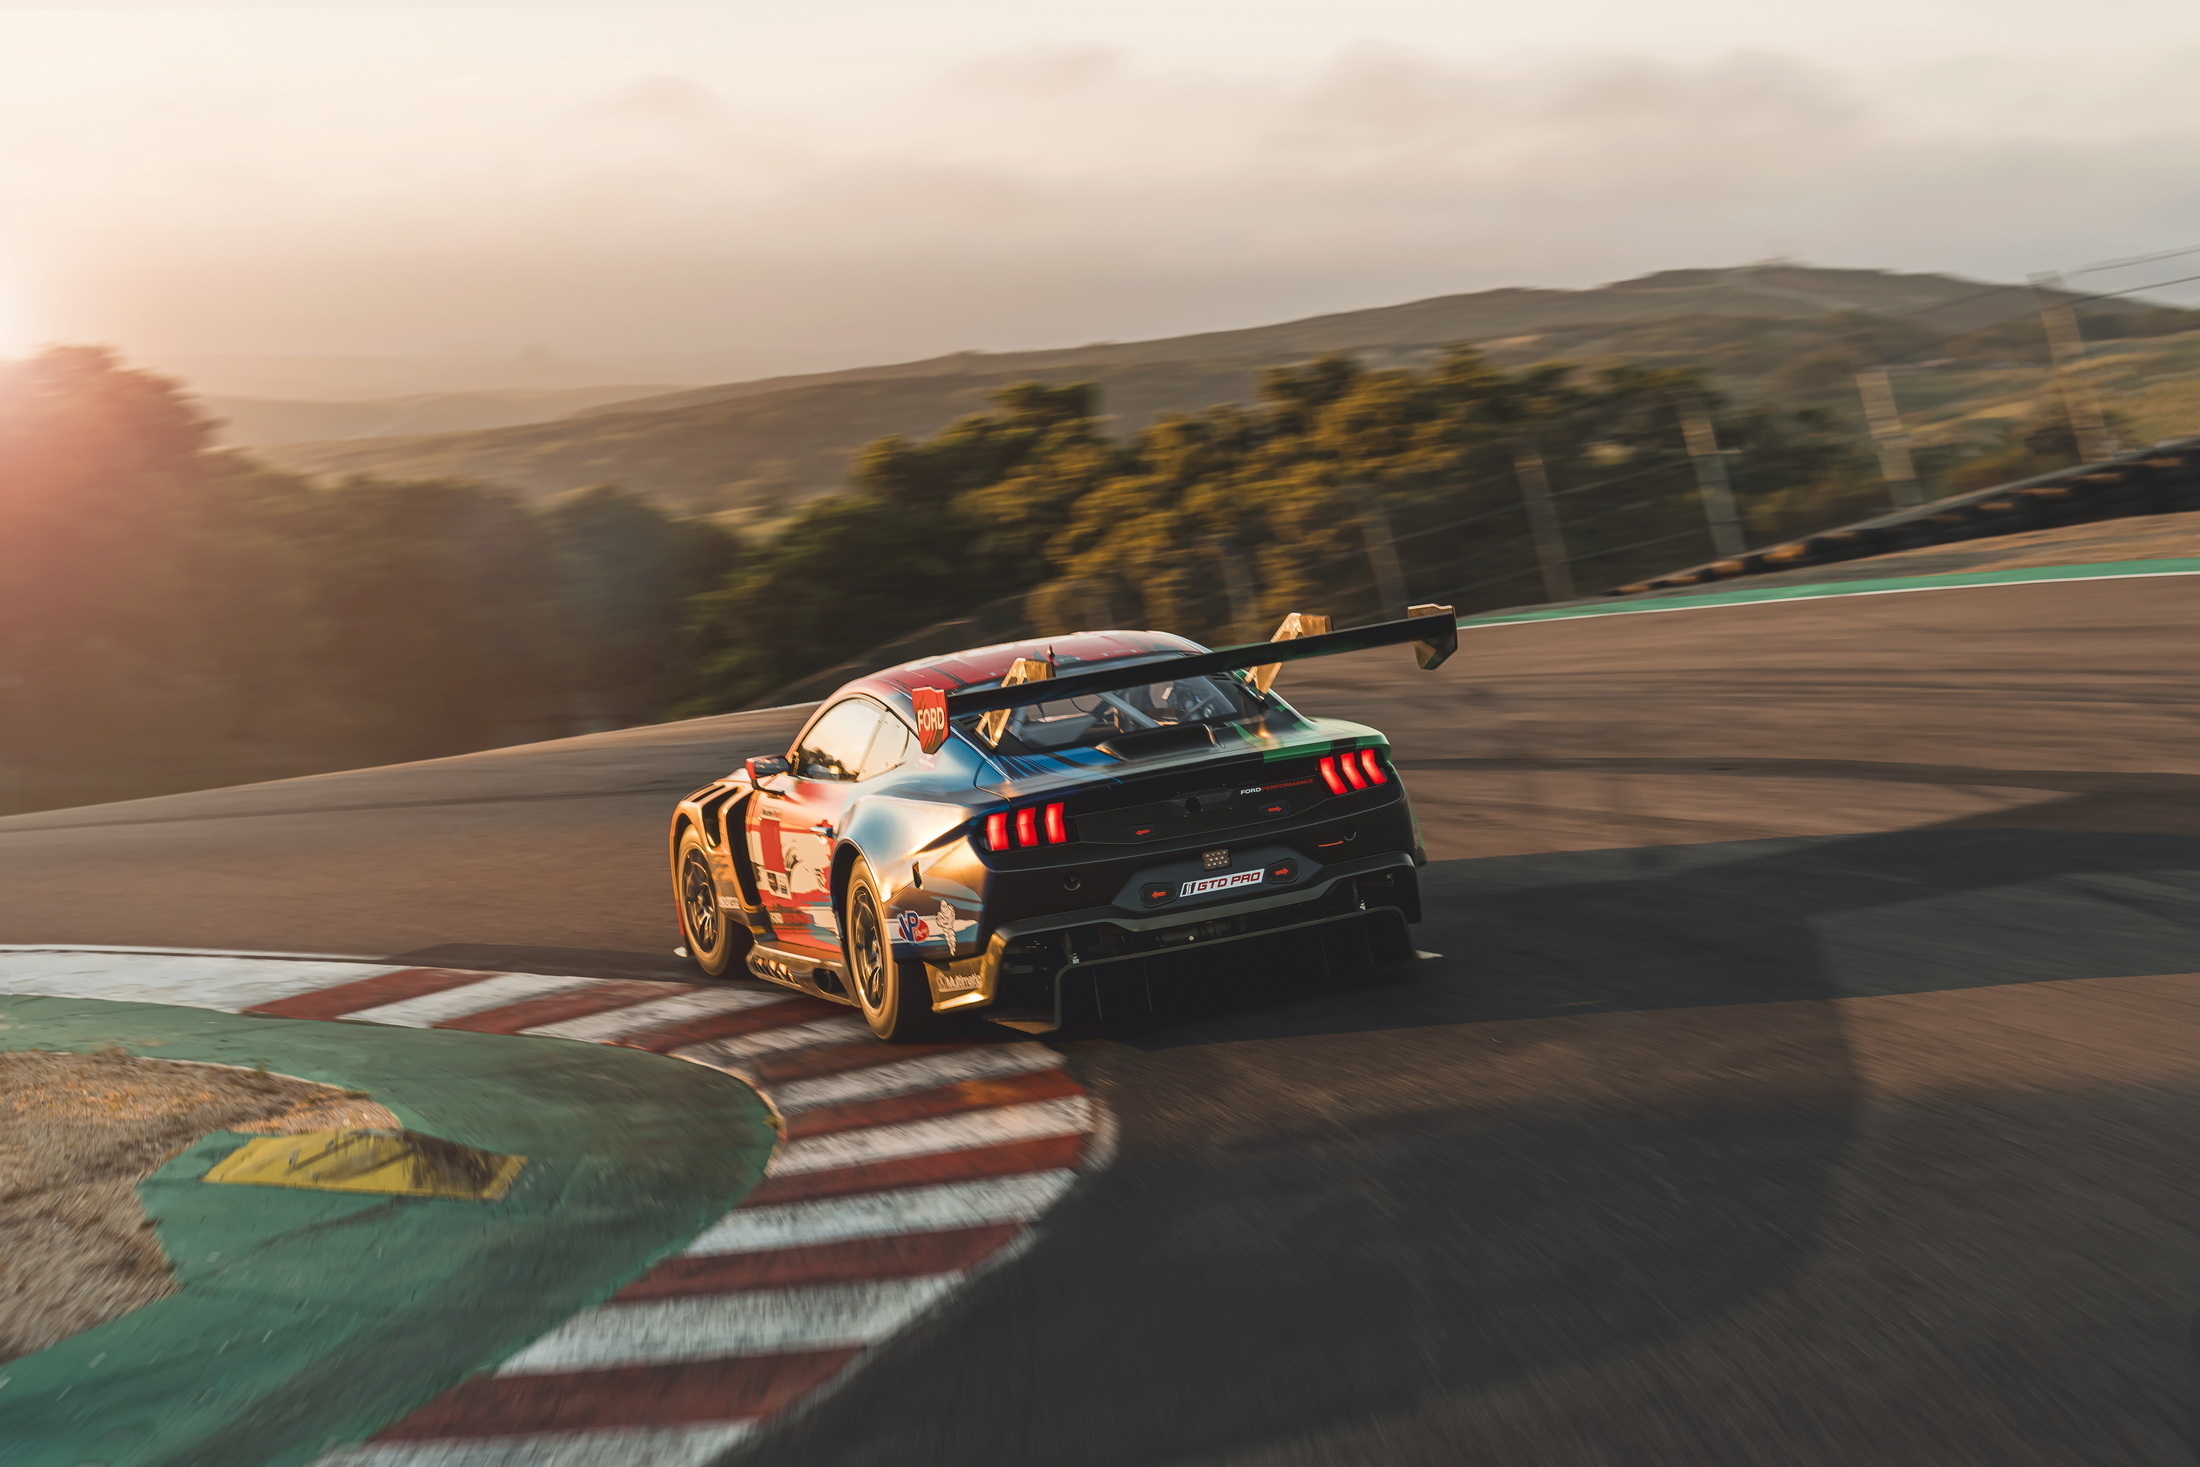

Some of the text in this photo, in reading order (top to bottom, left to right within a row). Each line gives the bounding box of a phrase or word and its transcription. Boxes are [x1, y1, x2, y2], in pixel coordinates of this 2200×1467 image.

[917, 706, 945, 732] FORD
[1197, 871, 1261, 892] GTD PRO
[898, 911, 919, 942] VP
